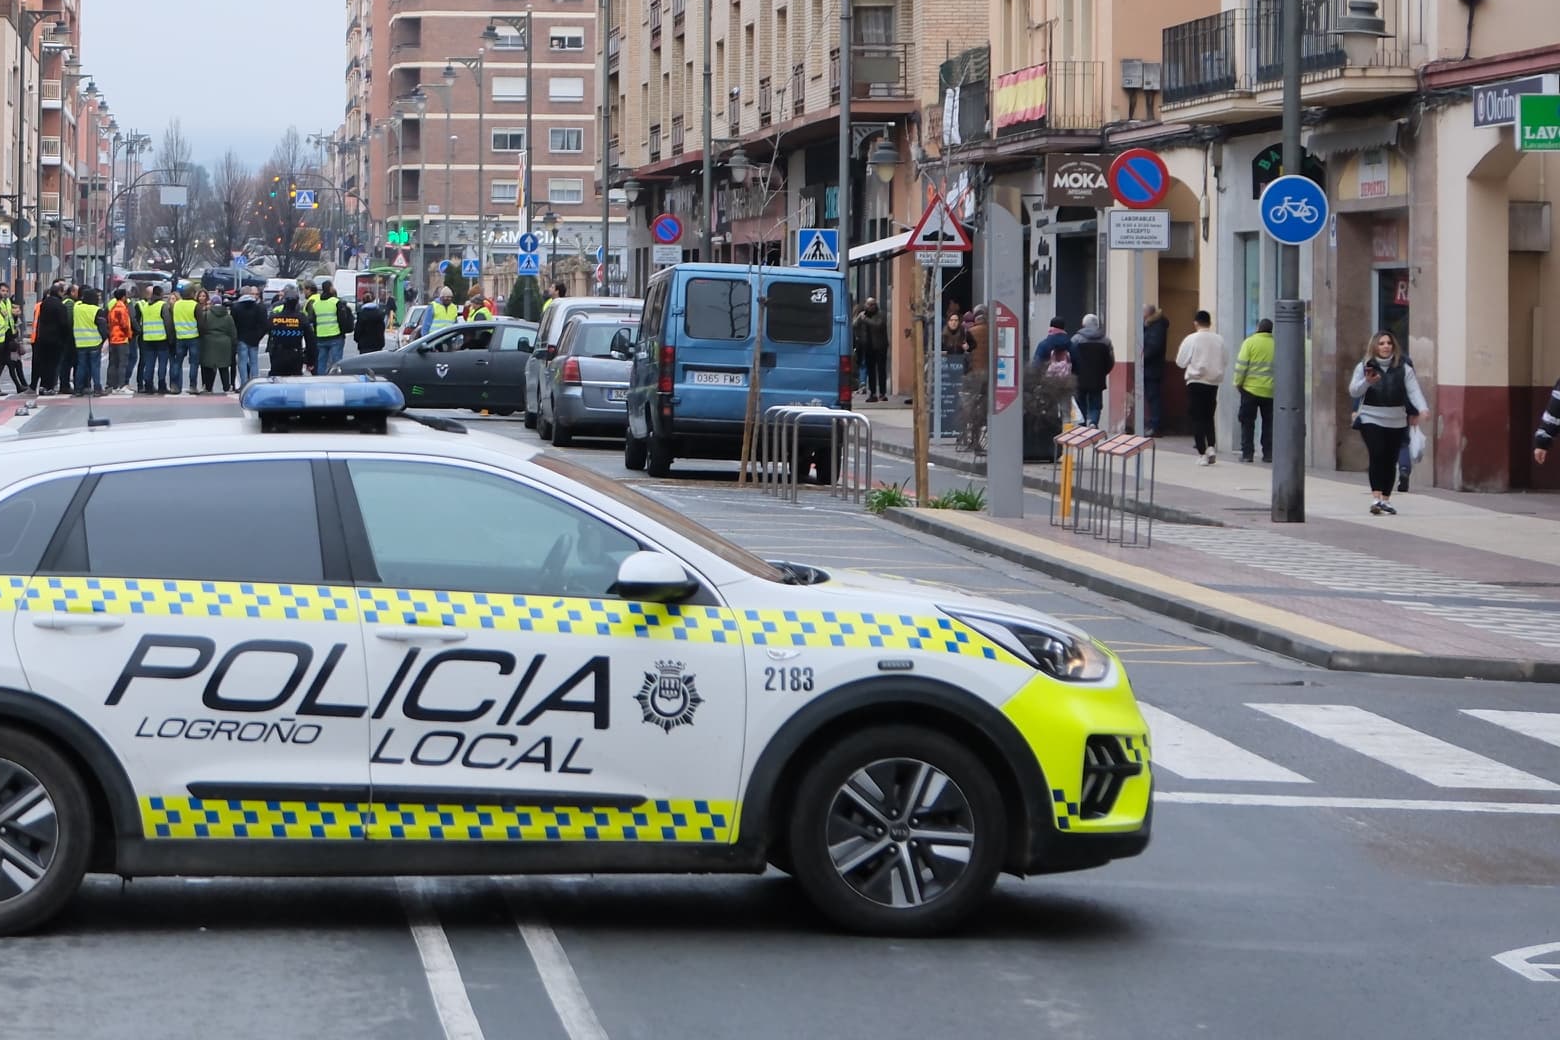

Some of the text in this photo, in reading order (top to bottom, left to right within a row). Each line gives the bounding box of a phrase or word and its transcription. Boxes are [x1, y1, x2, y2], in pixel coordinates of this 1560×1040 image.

[1524, 126, 1560, 139] LAV
[1053, 172, 1108, 188] MOKA
[696, 373, 741, 385] 0365 FMS
[104, 633, 610, 730] POLICIA
[763, 666, 815, 692] 2183
[135, 716, 323, 745] LOGROÑO
[369, 728, 594, 775] LOCAL
